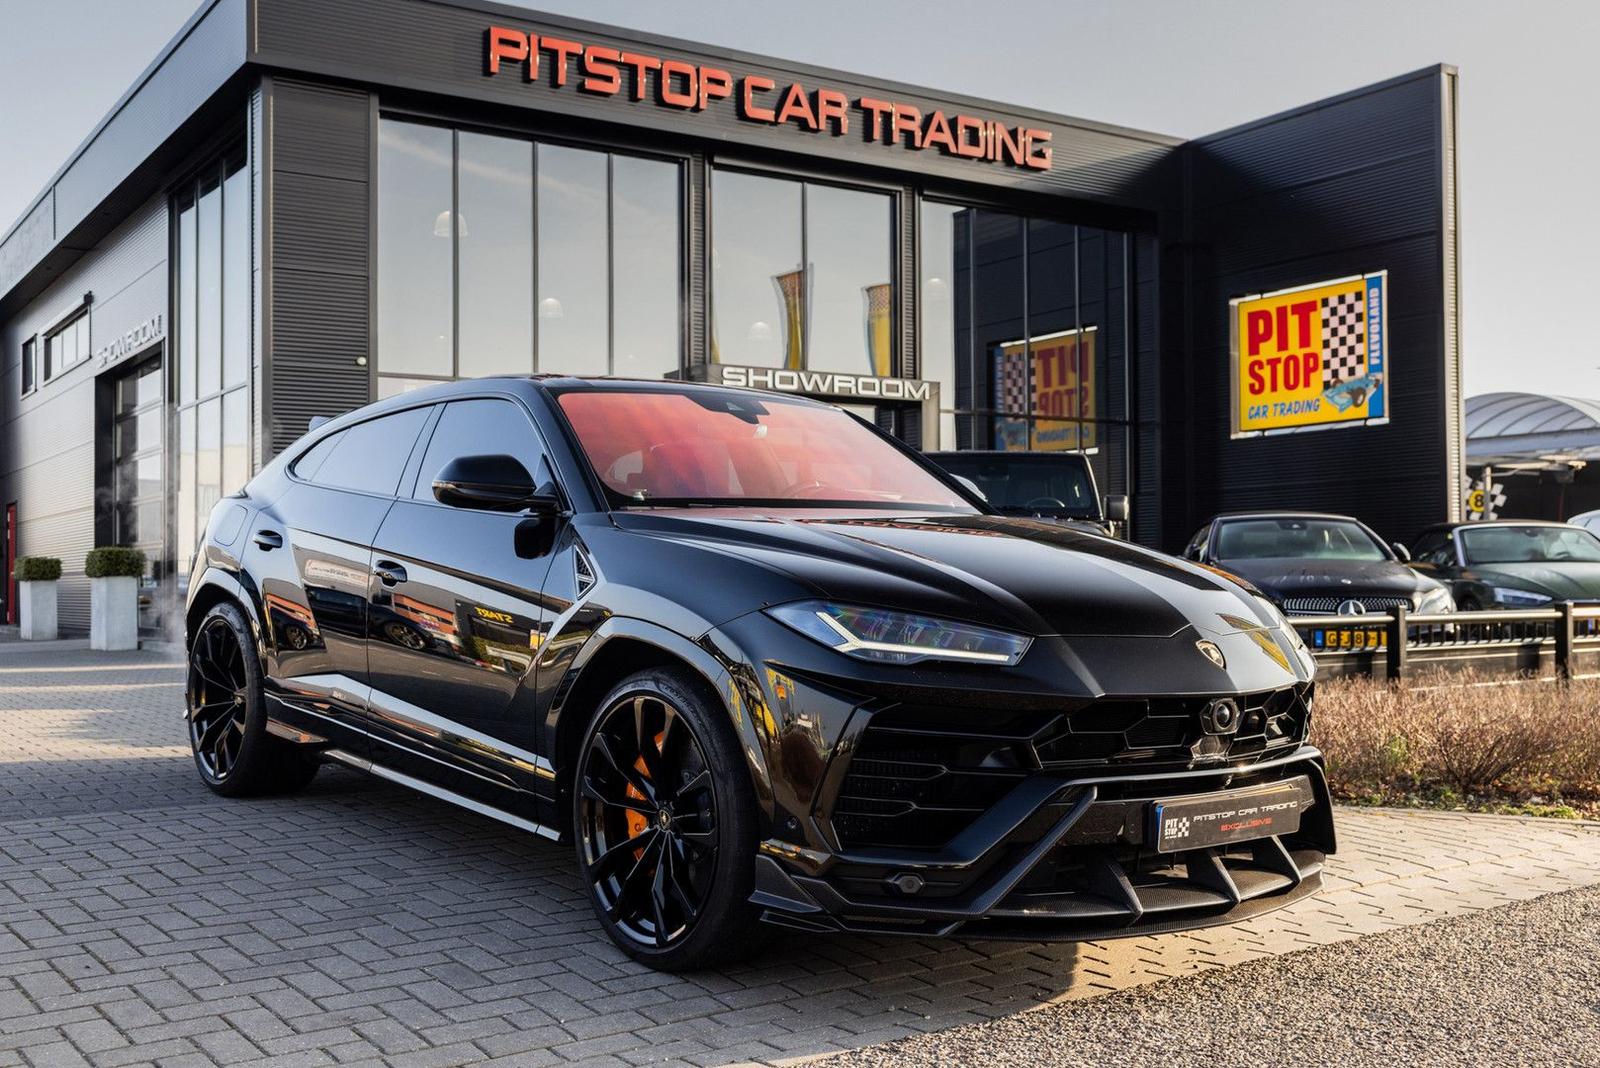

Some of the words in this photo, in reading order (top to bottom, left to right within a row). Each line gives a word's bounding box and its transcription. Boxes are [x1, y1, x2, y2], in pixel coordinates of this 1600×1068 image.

[488, 26, 733, 111] PITSTOP
[742, 75, 849, 135] CAR
[860, 97, 1053, 170] TRADING
[1247, 300, 1318, 356] PIT
[1369, 287, 1381, 366] FLEVOLAND
[722, 366, 930, 400] SHOWROOM
[1248, 352, 1319, 396] STOP
[1248, 404, 1268, 420] CAR
[1273, 398, 1320, 417] TRADING
[1165, 817, 1179, 830] PIT
[1193, 811, 1236, 822] PITSTOP
[1238, 807, 1258, 816] CAR
[1261, 802, 1298, 812] TRADING
[1221, 818, 1272, 831] EXCLUSIVE
[1164, 828, 1178, 837] STOP
